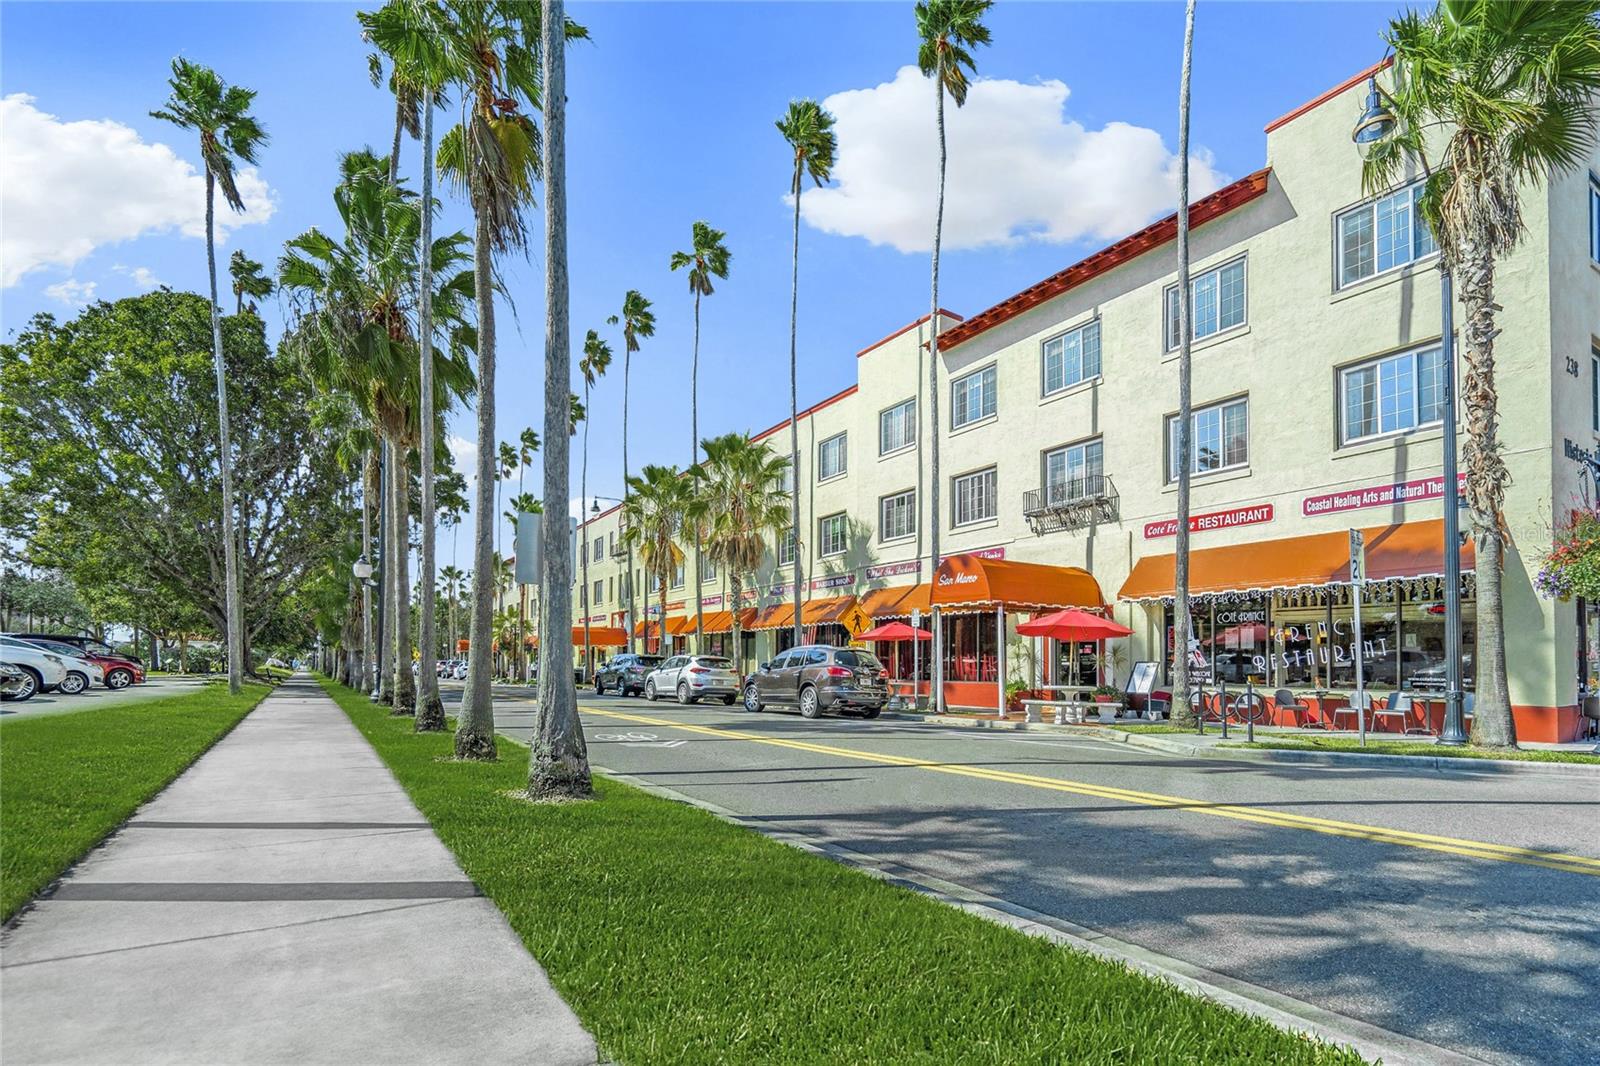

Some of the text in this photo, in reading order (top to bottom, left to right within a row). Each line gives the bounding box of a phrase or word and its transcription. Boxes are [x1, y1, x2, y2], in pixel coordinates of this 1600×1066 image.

[1566, 356, 1579, 378] 238
[1306, 478, 1468, 513] Coastal Healing Arts and Natural Theres
[1166, 520, 1195, 534] Fre
[1198, 507, 1270, 529] RESTAURANT
[938, 571, 978, 586] San Marco
[1252, 638, 1387, 673] RESTAURANT
